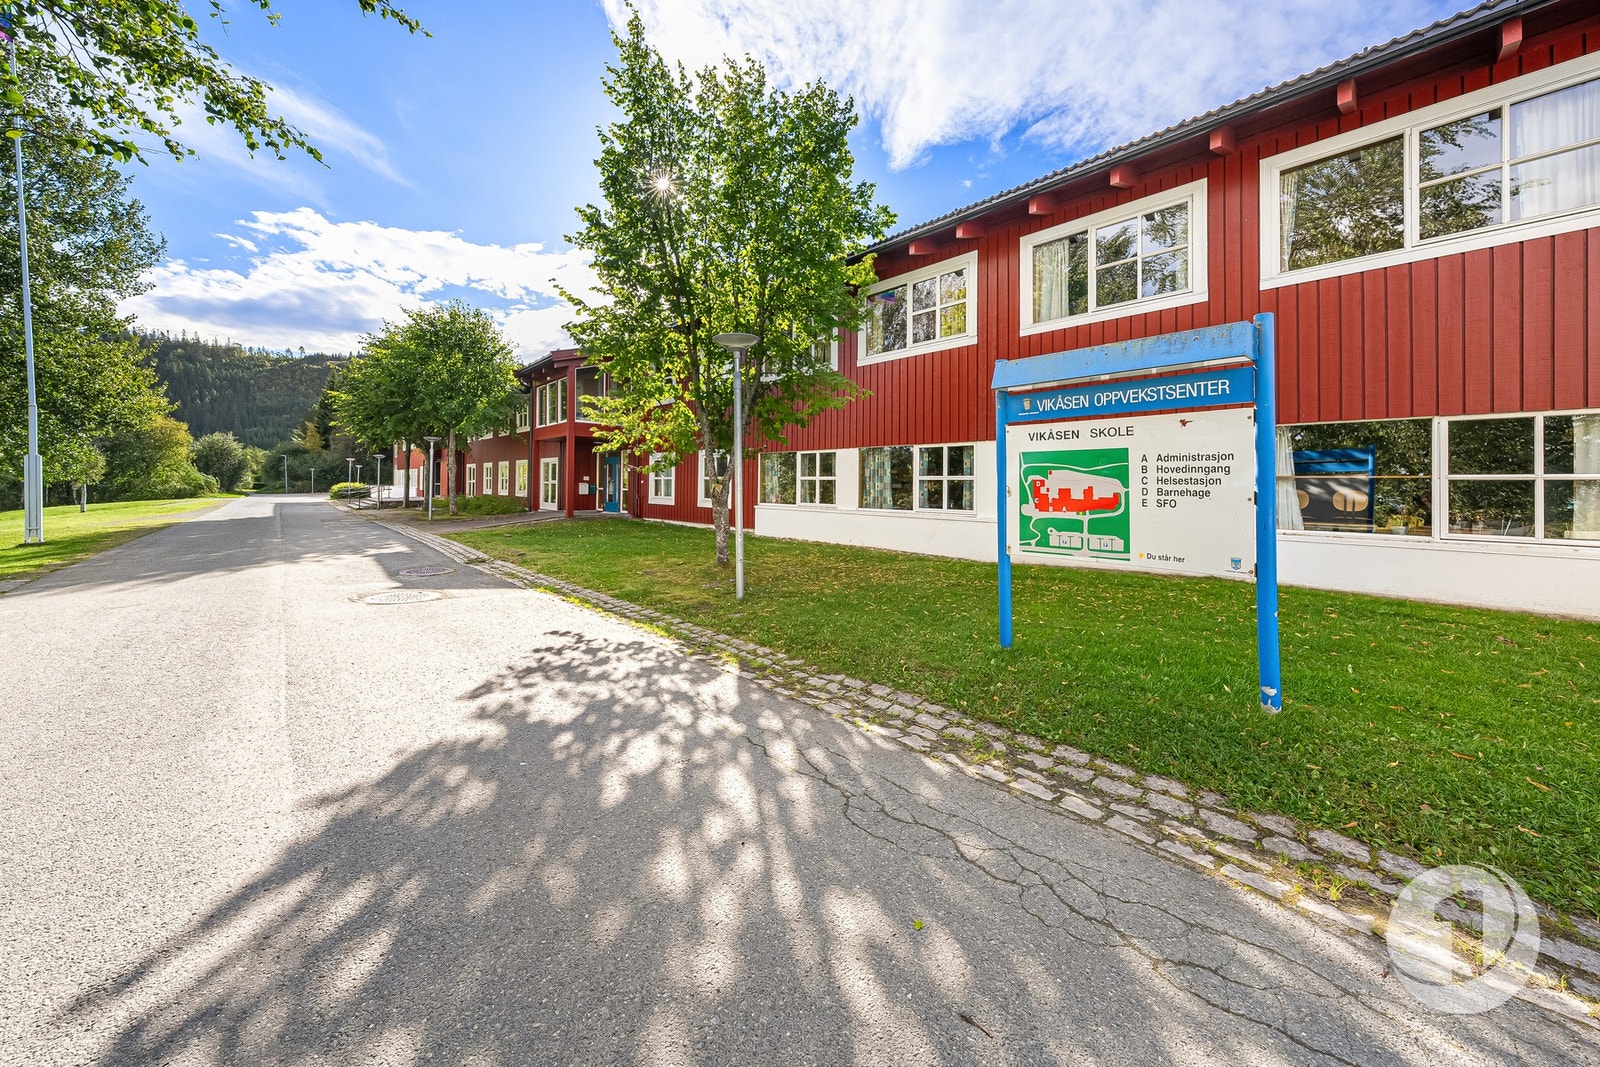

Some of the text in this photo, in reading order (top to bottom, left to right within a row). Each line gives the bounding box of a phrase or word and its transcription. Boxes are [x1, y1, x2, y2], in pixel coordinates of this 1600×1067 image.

[1036, 379, 1230, 412] VIKÅSEN OPPVEKSTSENTER
[1028, 426, 1135, 442] VIKÅSEN SKOLE
[1141, 451, 1235, 464] A Administrasjon
[1141, 464, 1231, 476] B Hovedinngang
[1141, 475, 1222, 488] C Helsestasjon
[1141, 487, 1211, 500] D Barnehage
[1141, 498, 1177, 509] E SFO
[1146, 552, 1185, 563] Du står her
